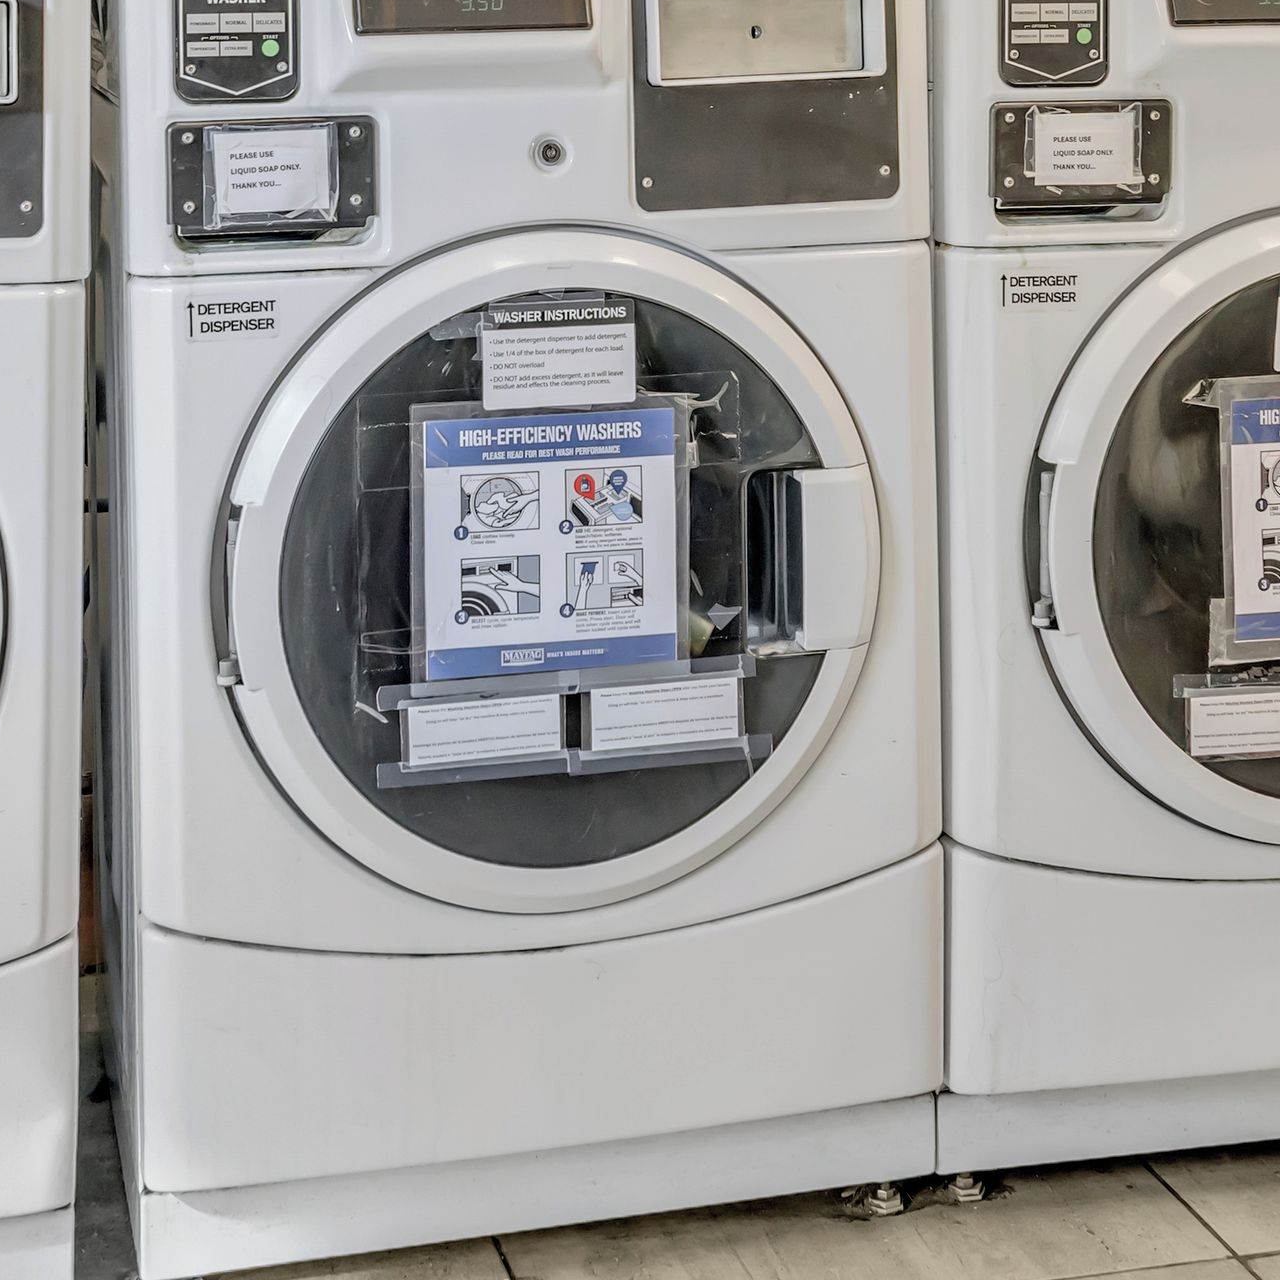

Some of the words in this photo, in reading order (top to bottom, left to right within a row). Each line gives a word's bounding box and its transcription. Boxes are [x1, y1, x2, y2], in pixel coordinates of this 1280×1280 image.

[230, 152, 258, 160] PLEASE
[259, 150, 274, 159] USE
[230, 167, 256, 176] LIQUID
[258, 165, 279, 173] SOAP
[280, 164, 301, 172] ONLY.
[232, 182, 257, 190] THANK
[1010, 275, 1078, 287] DETERGENT
[1012, 292, 1076, 304] DISPENSER
[197, 300, 276, 316] DETERGENT
[493, 311, 542, 323] WASHER
[544, 307, 626, 321] INSTRUCTIONS
[200, 318, 274, 334] DISPENSER
[459, 426, 573, 448] HIGH-EFFICIENCY
[577, 421, 642, 441] WASHERS
[482, 451, 506, 460] PLEASE
[507, 449, 524, 459] READ
[525, 449, 537, 458] FOR
[538, 448, 554, 458] BEST
[555, 447, 574, 457] WASH
[575, 445, 620, 456] PERFORMANCE
